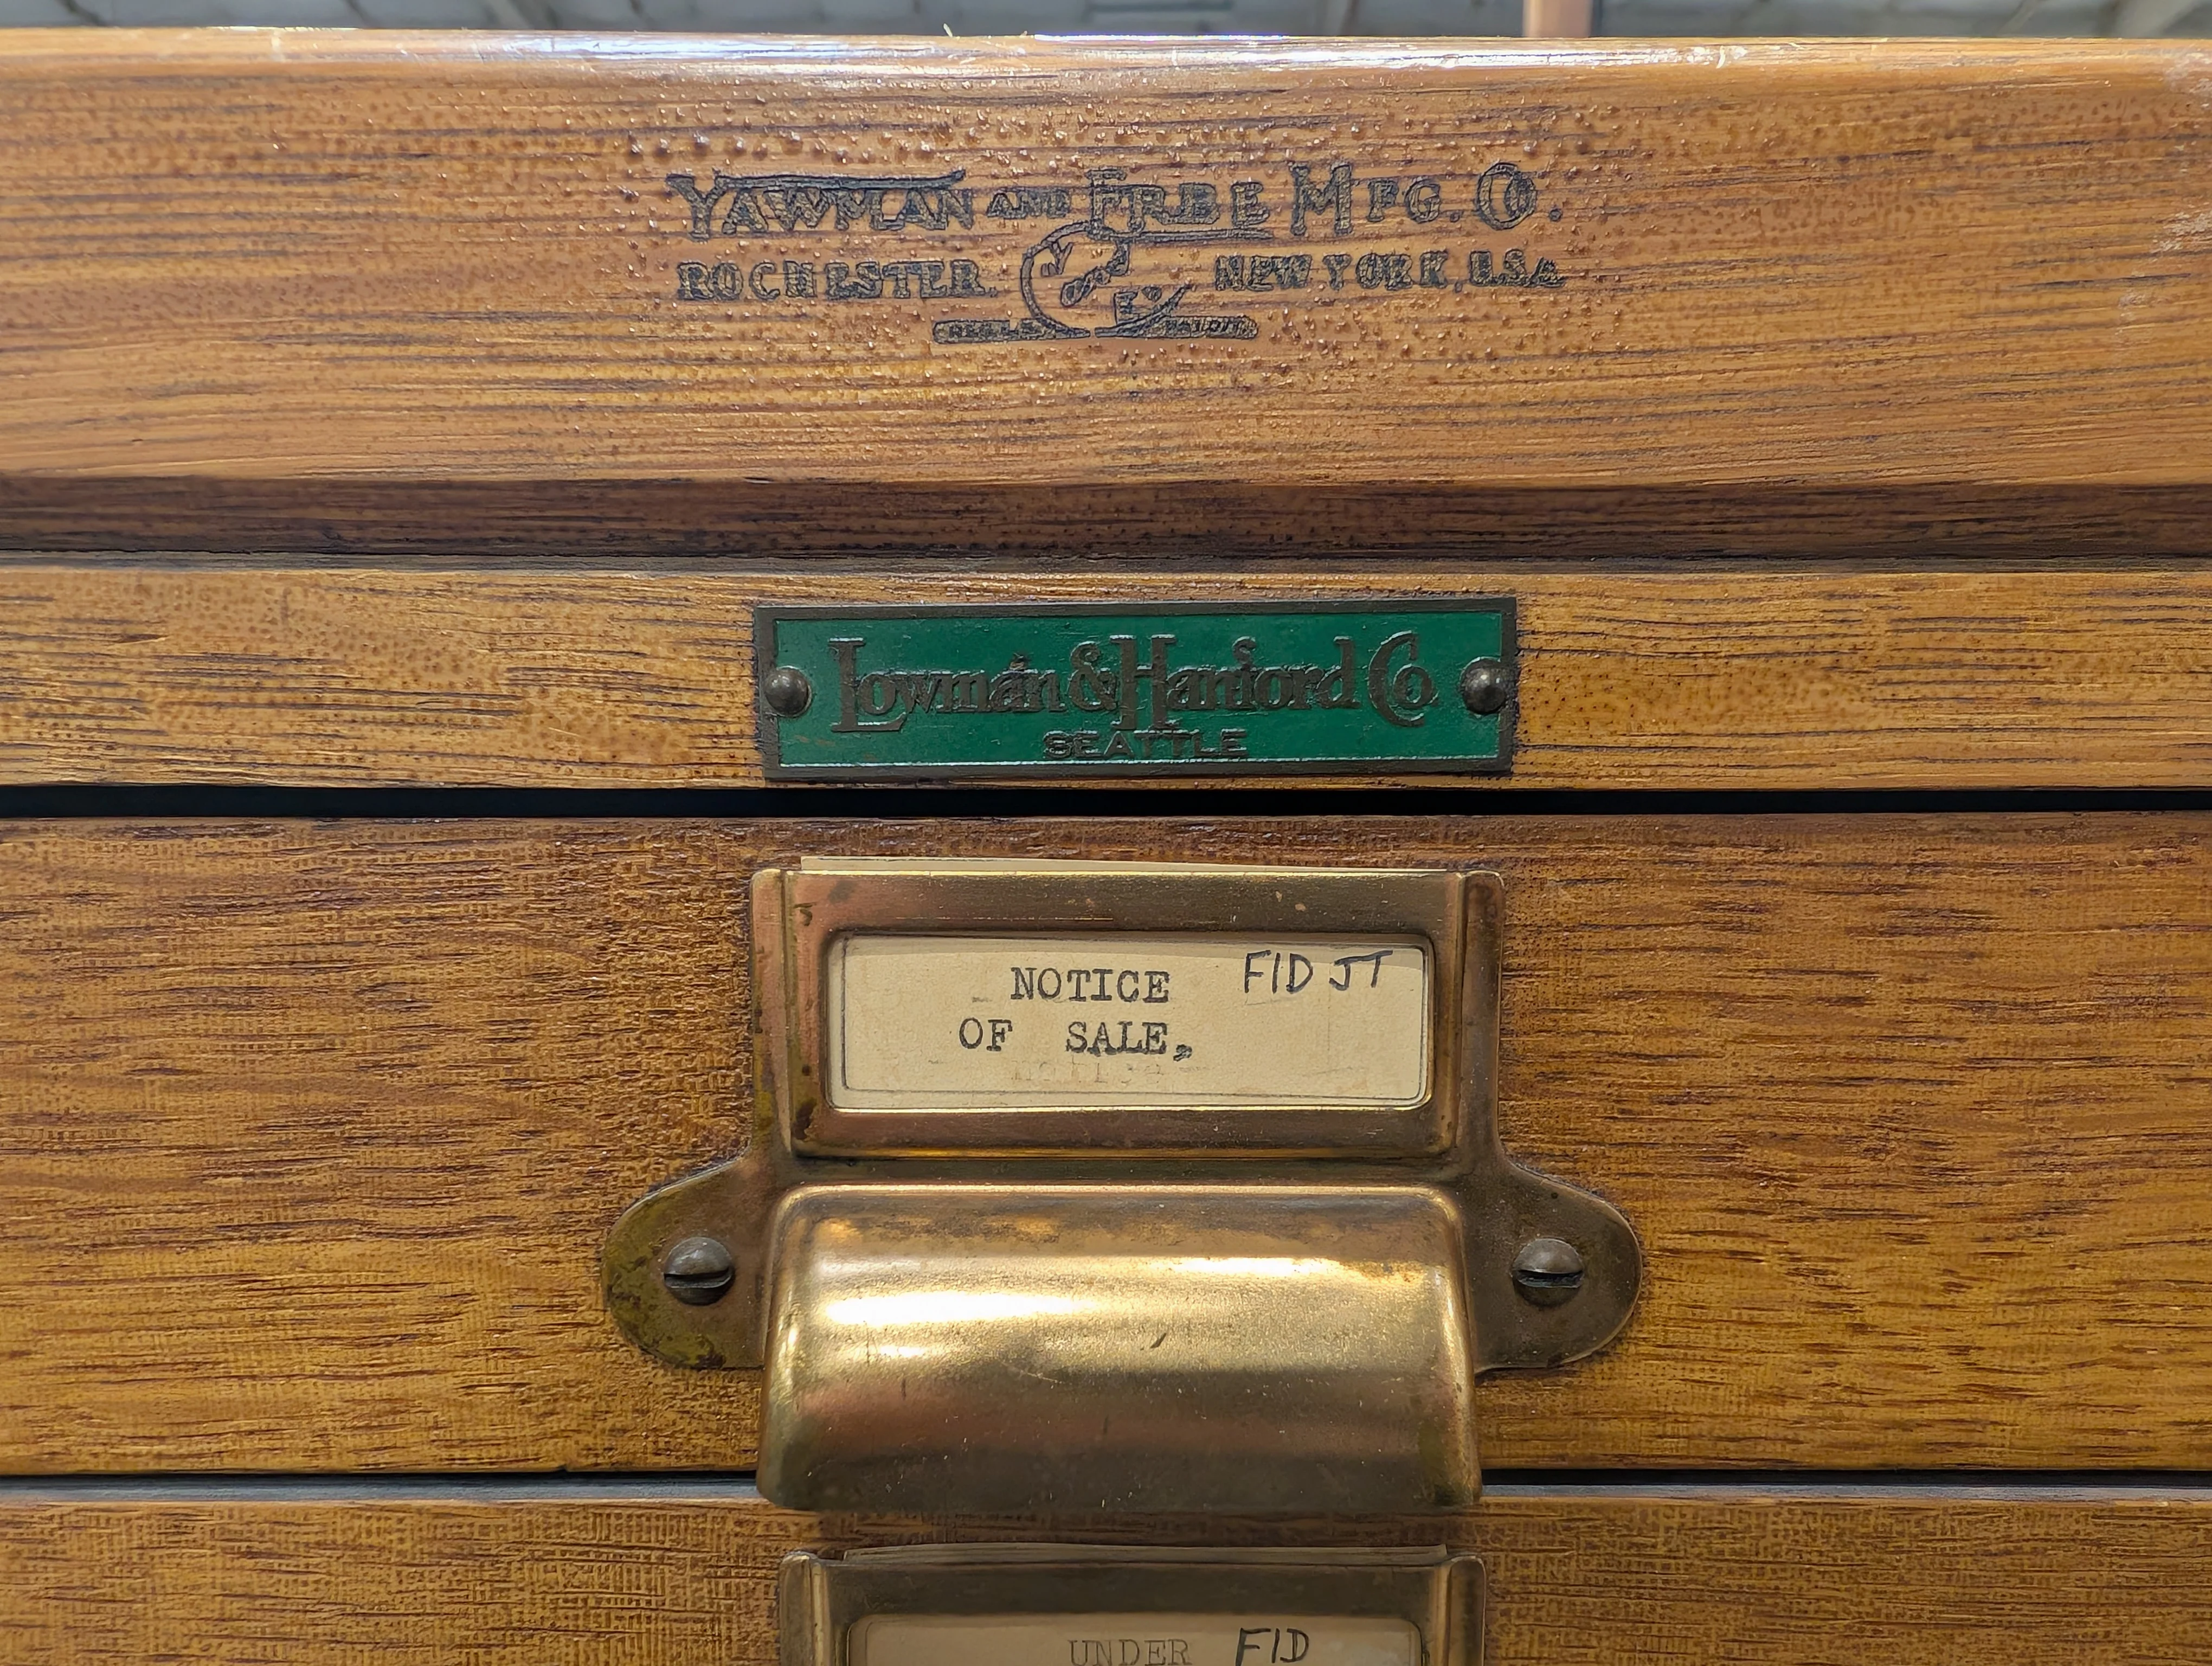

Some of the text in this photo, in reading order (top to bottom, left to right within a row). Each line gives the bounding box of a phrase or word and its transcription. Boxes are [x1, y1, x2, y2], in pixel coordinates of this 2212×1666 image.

[1213, 255, 1313, 291] NEW
[828, 637, 1067, 733] Lowman
[1067, 641, 1118, 713] &
[1109, 633, 1361, 732] Hanford
[1043, 728, 1248, 758] SEATTLE
[1010, 967, 1171, 1004] NOTICE
[1244, 950, 1313, 995] FID
[959, 1017, 1013, 1052] OF
[1068, 1638, 1193, 1666] UNDER
[1234, 1627, 1310, 1666] FID
